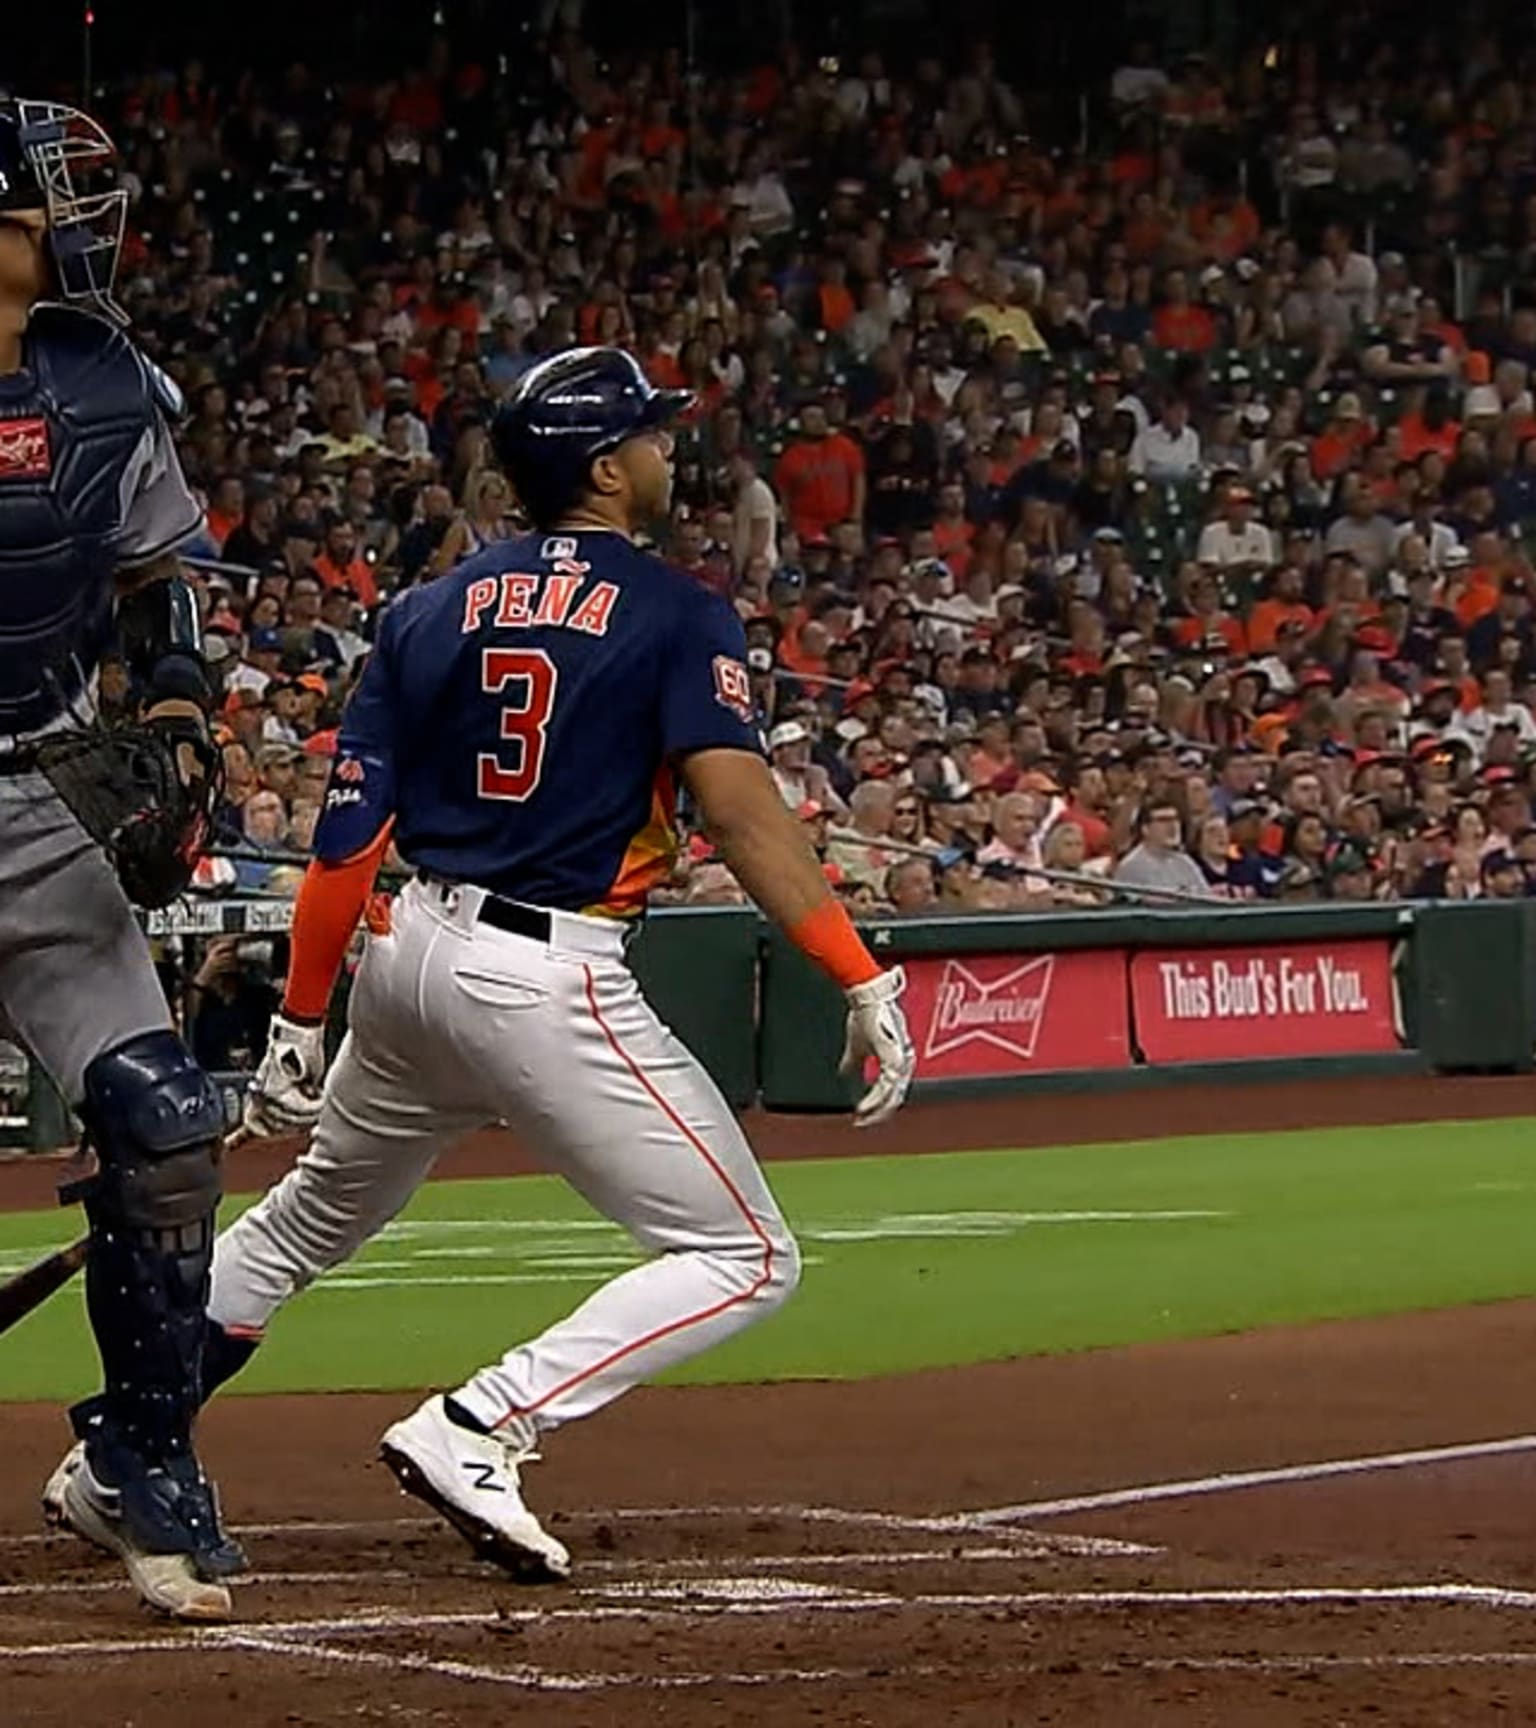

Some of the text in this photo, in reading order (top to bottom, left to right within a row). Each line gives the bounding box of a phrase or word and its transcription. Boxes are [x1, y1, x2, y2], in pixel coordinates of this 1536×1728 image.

[462, 558, 620, 637] PEÑA
[477, 647, 558, 802] 3
[1159, 955, 1368, 1018] This Bud's For You.
